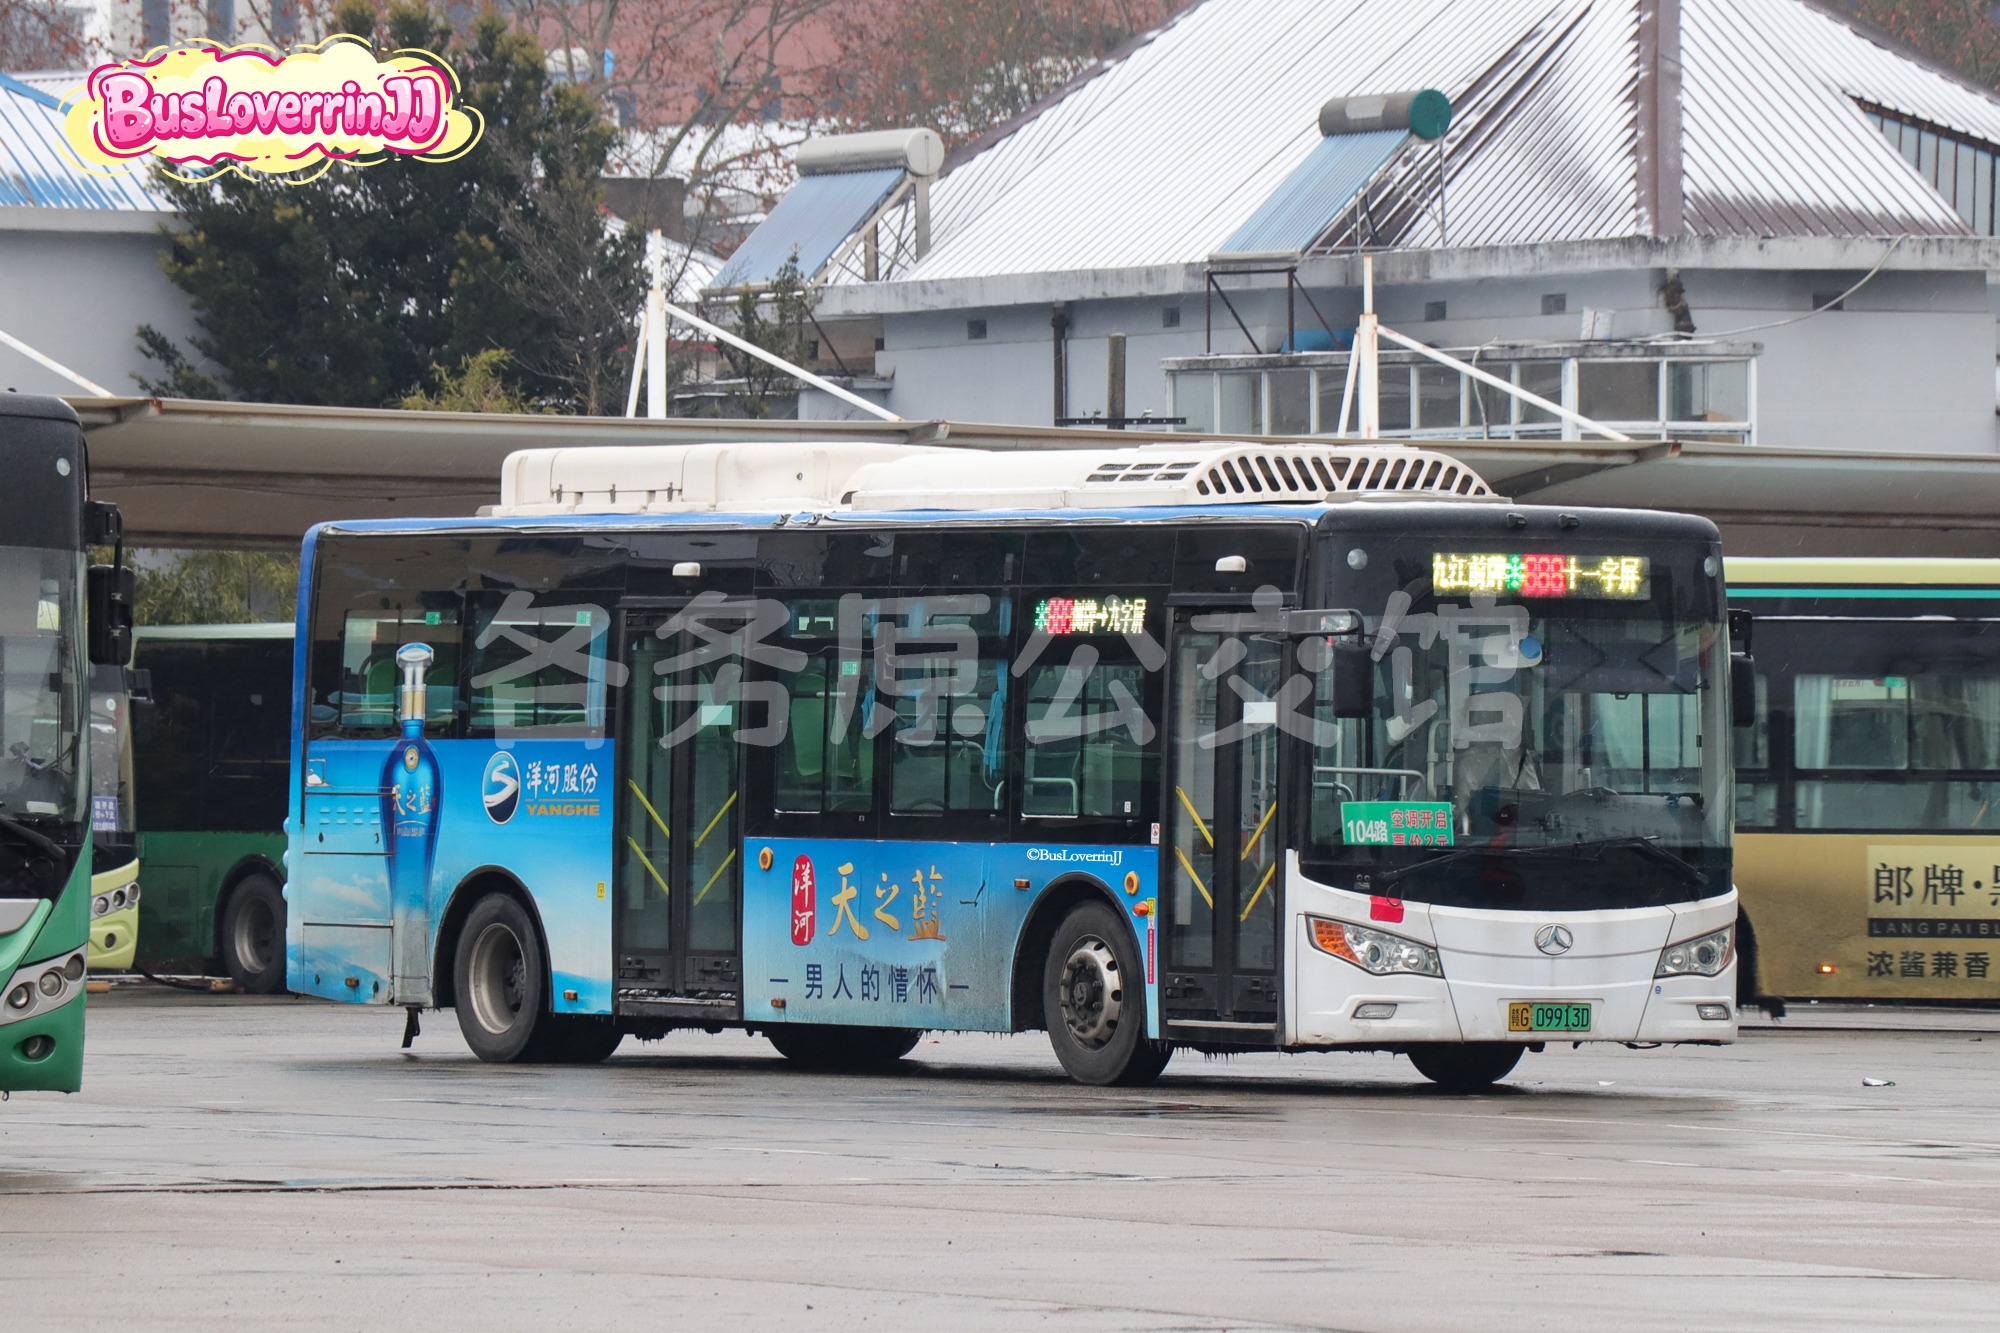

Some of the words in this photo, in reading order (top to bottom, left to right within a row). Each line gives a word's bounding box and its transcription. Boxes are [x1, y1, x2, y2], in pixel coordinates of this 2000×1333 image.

[526, 761, 599, 800] 洋河股份
[526, 804, 600, 816] YANGHE
[1390, 810, 1448, 829] 空调开启
[1347, 819, 1388, 843] 104路
[794, 861, 813, 942] 洋河
[1872, 922, 1930, 935] LANG
[1937, 922, 1972, 935] PAI
[1866, 950, 1991, 979] 浓酱兼香
[805, 963, 938, 1004] 男人的情怀
